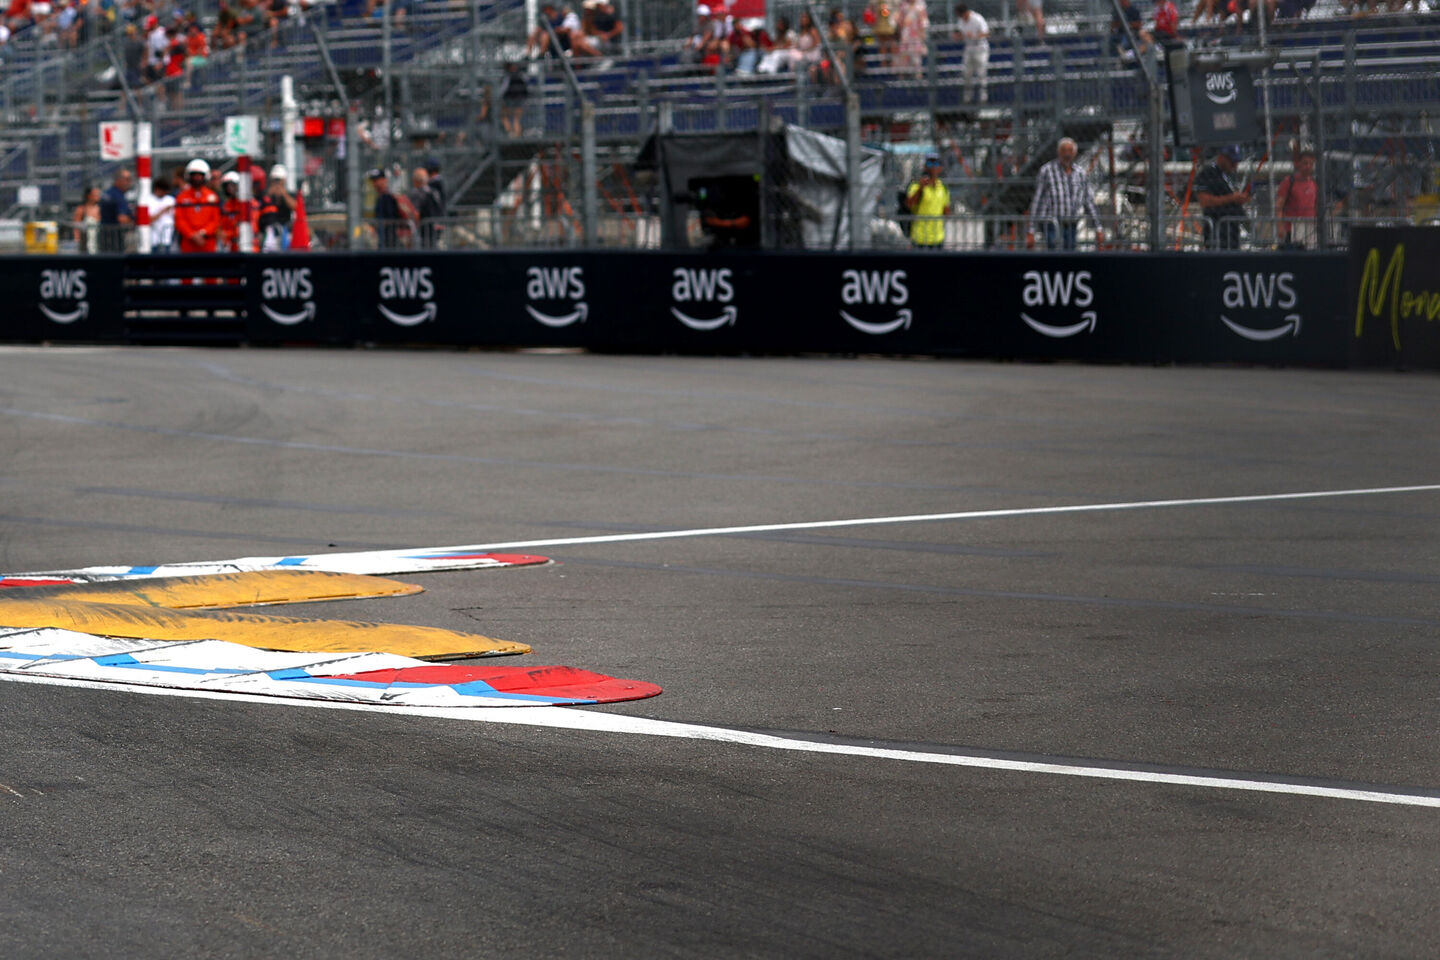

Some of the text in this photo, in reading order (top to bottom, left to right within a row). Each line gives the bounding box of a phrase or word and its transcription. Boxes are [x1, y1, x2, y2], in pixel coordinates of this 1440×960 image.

[1205, 72, 1235, 90] aws
[40, 270, 86, 299] aws
[262, 268, 312, 299] aws
[379, 267, 434, 300] aws
[527, 267, 585, 299] aws
[672, 268, 734, 302] aws
[841, 269, 909, 305] aws
[1022, 271, 1094, 307] aws
[1222, 271, 1297, 309] aws
